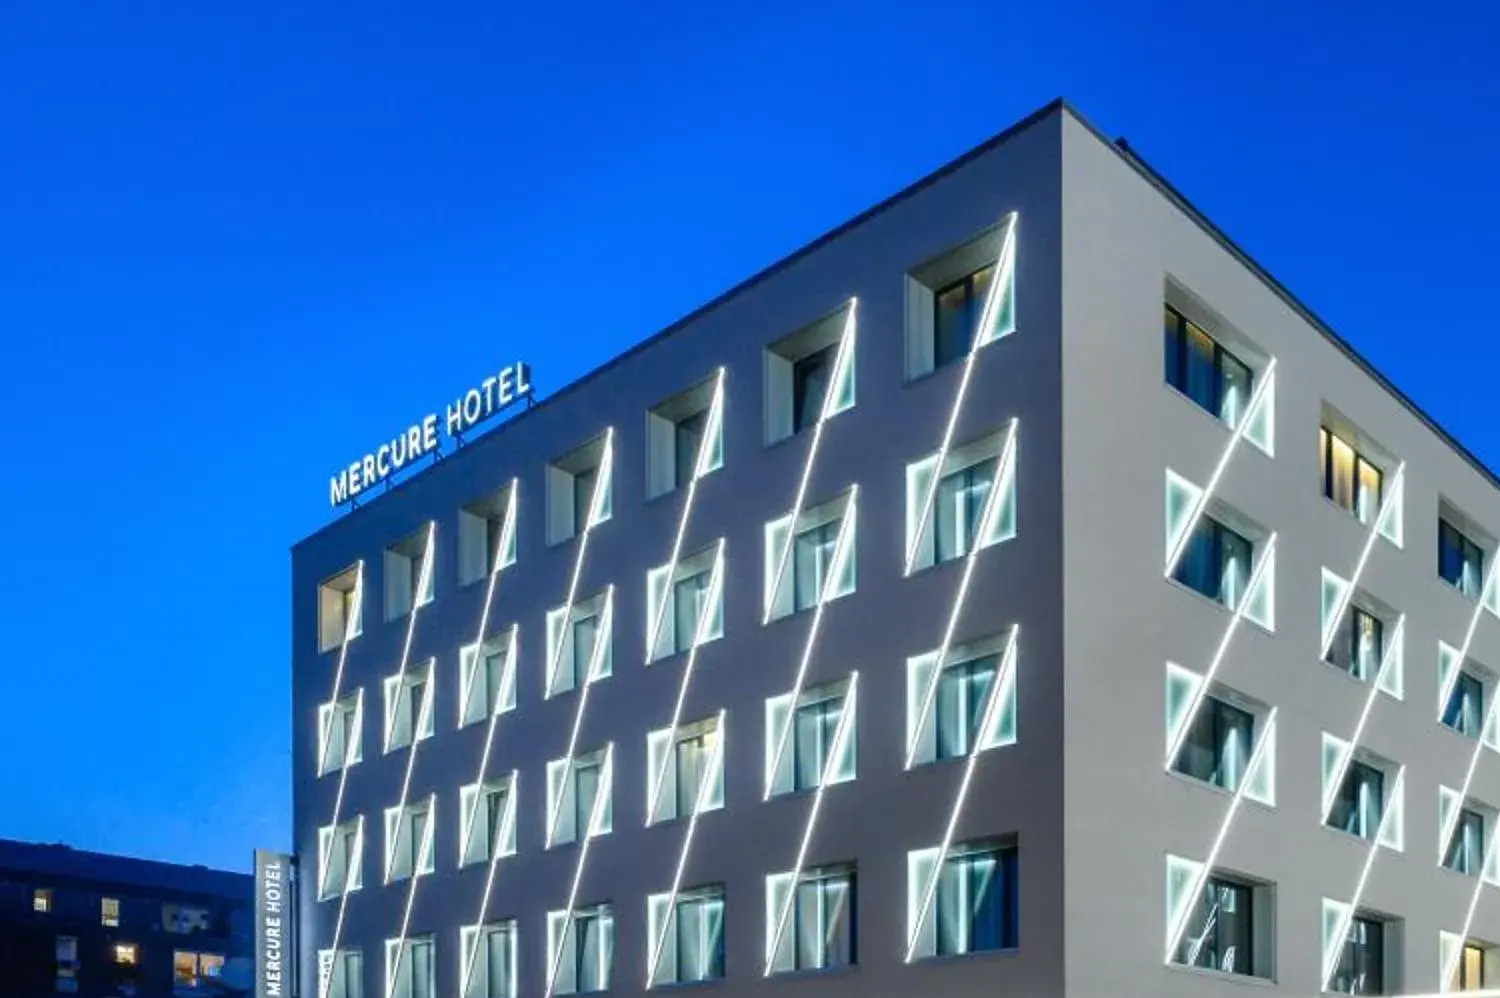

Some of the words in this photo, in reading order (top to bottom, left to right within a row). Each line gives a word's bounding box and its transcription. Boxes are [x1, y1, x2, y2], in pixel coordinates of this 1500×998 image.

[330, 413, 438, 507] MERCURE
[447, 360, 530, 436] HOTEL
[265, 861, 281, 912] HOTEL
[266, 917, 281, 996] MERCURE
